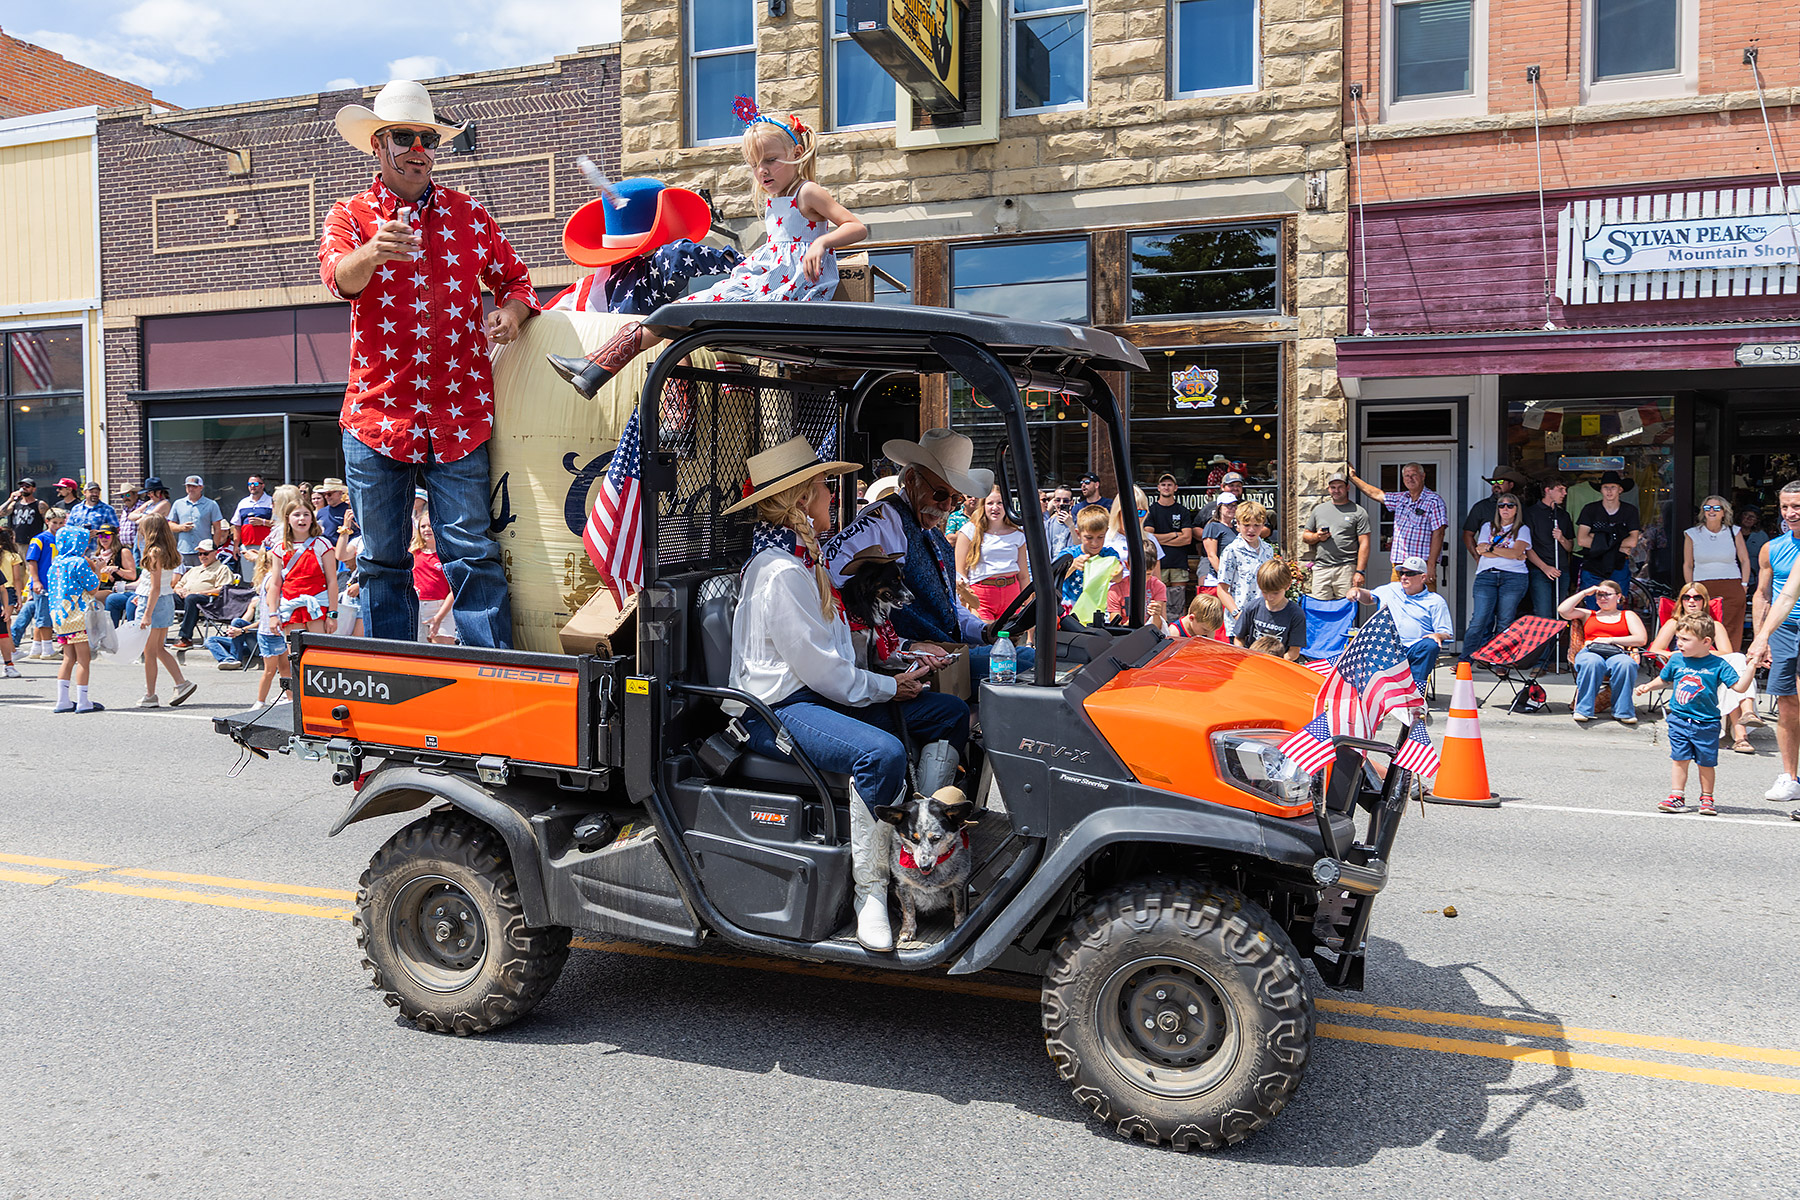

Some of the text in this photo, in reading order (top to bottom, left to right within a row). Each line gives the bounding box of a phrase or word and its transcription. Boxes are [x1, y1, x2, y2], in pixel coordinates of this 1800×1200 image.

[1602, 228, 1691, 266] SYLVAN
[1695, 224, 1752, 243] PEAK
[1667, 244, 1798, 262] Mountain Shop
[1753, 347, 1763, 361] 9
[1185, 383, 1205, 395] 50
[1173, 494, 1208, 510] AMOUS
[307, 669, 390, 700] Kubota
[477, 666, 571, 685] DIESEL
[1018, 737, 1091, 764] RTV-X
[1060, 773, 1109, 790] Power Steering
